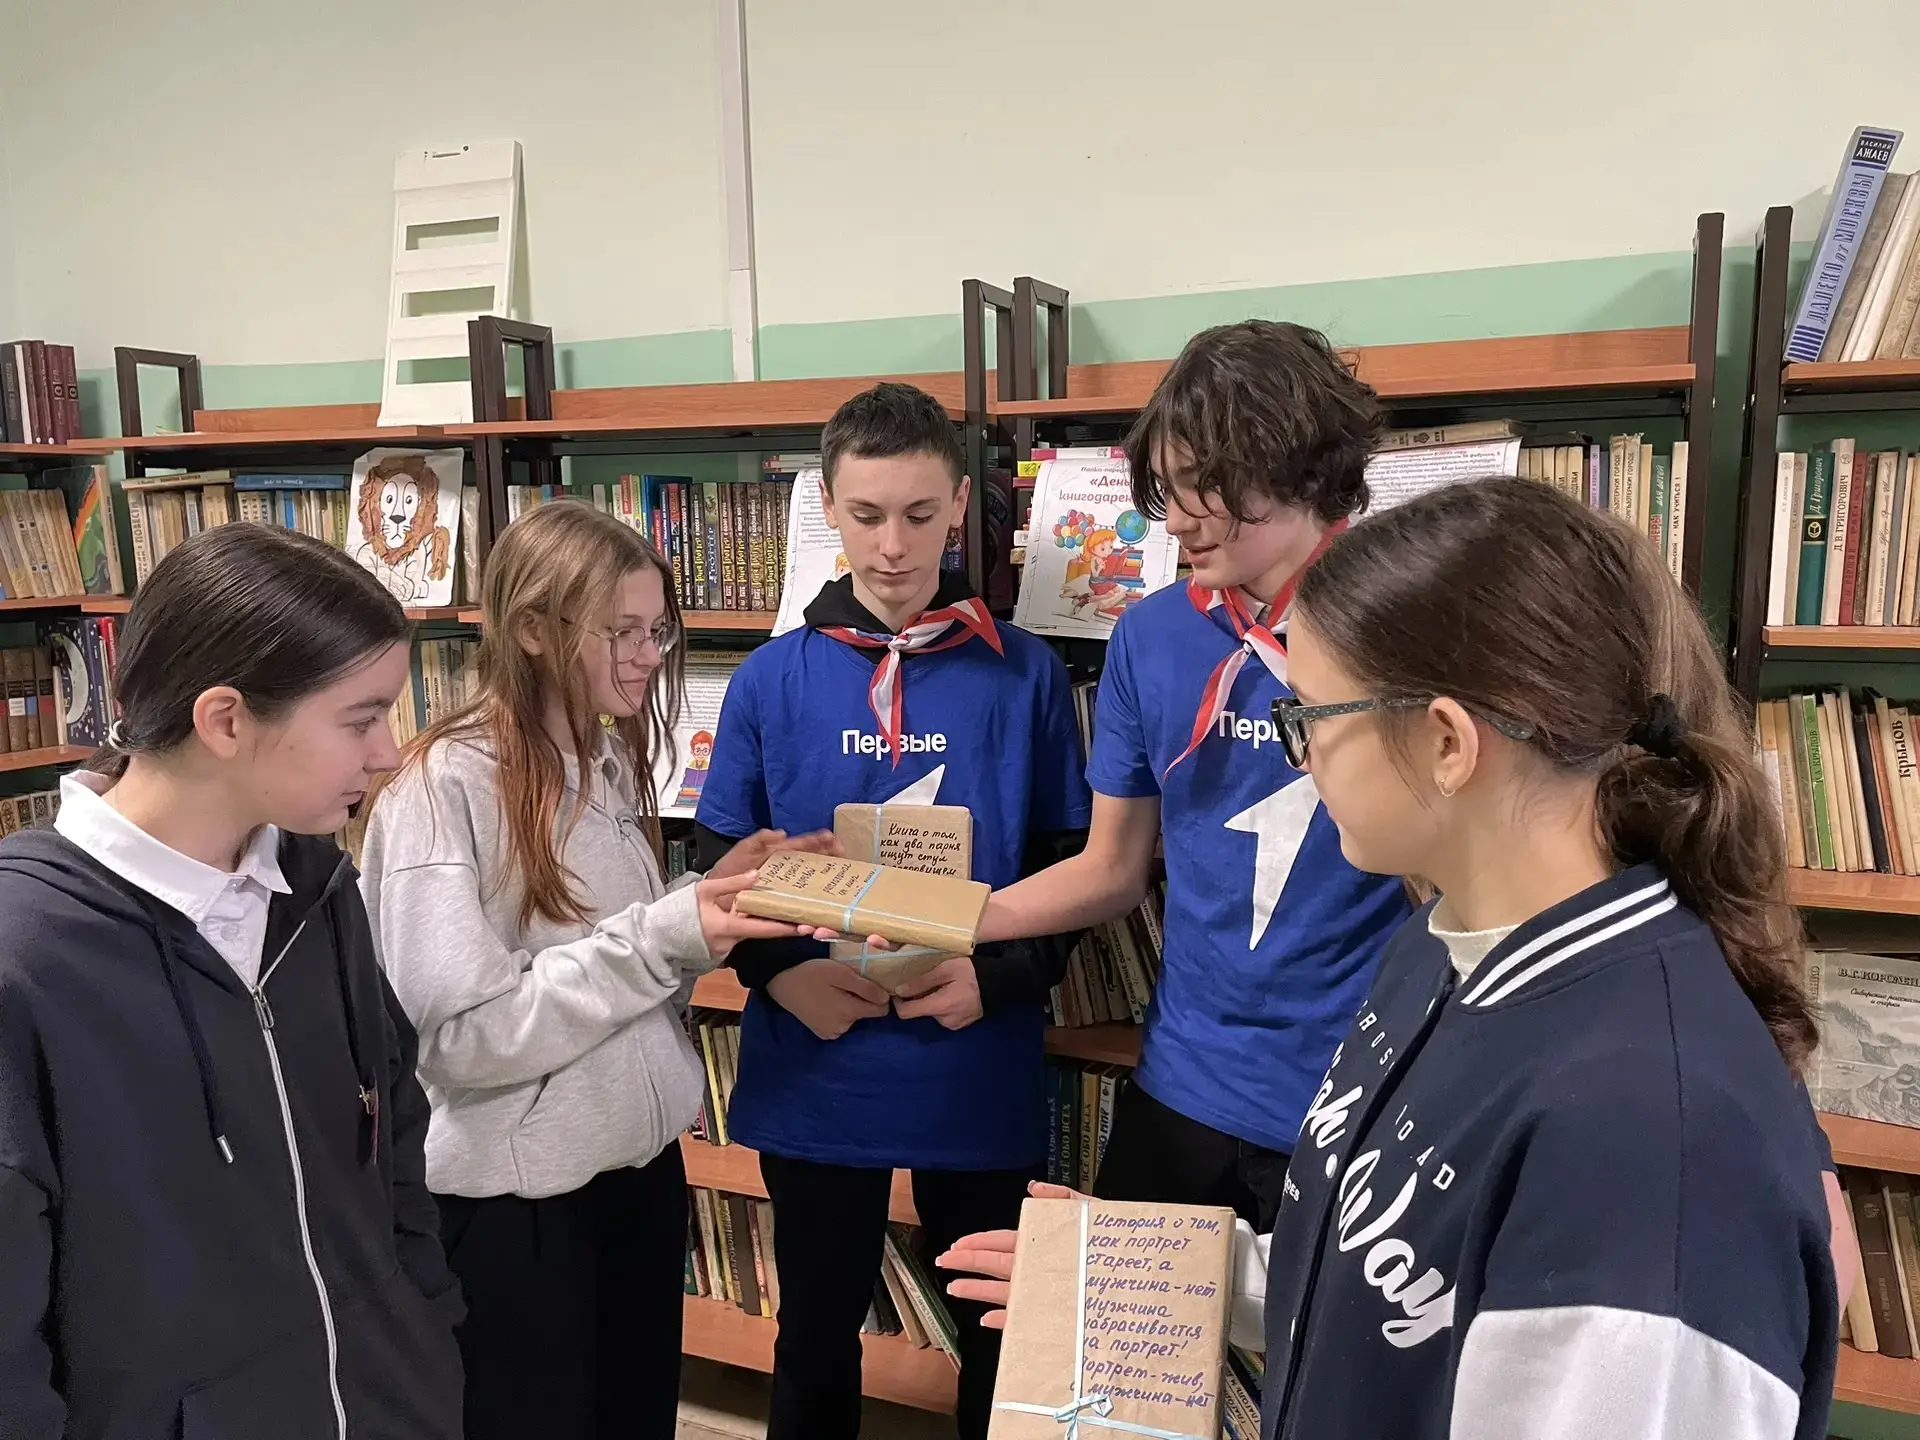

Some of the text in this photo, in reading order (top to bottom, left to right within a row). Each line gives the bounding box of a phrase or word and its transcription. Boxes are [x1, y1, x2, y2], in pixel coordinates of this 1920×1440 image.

[1856, 147, 1889, 161] АЖАЕВ
[1807, 261, 1843, 324] ДАЛЕКО
[1833, 173, 1875, 244] МОСКВЫ
[1835, 475, 1848, 533] ГРИГОРОВИЧ
[842, 729, 947, 761] Первые
[1810, 730, 1822, 767] КРЫЛОВ
[888, 823, 919, 836] Книга
[880, 838, 961, 854] как два парня
[880, 850, 948, 866] ищут стул
[1061, 1103, 1071, 1133] ВСЕХ
[1395, 1103, 1456, 1191] OAD
[1093, 1213, 1221, 1236] История о том,
[1087, 1234, 1192, 1254] как портрет
[1338, 1149, 1456, 1349] Way
[1086, 1253, 1174, 1272] стареет, а
[1085, 1296, 1173, 1319] Мужчина
[1110, 1338, 1188, 1360] портрет!
[1162, 1371, 1204, 1394] жив,
